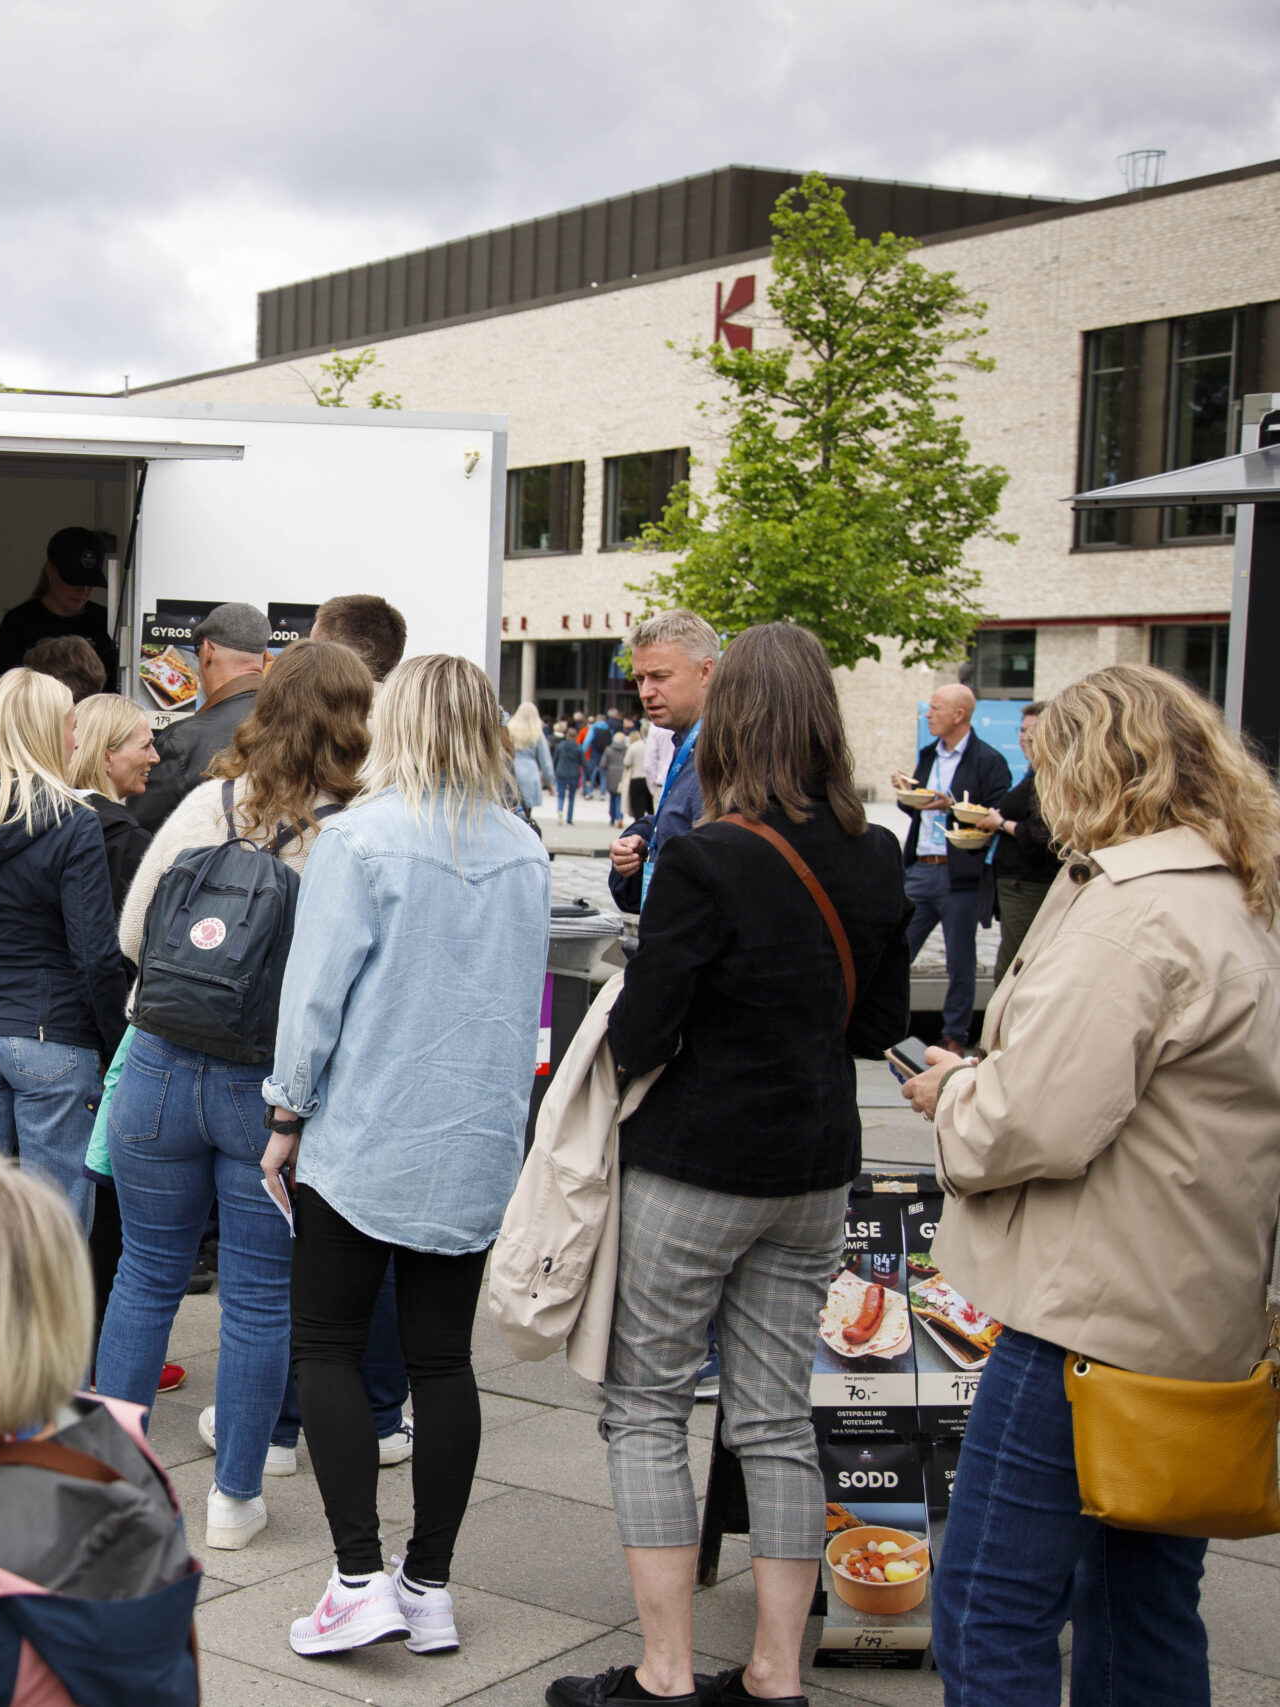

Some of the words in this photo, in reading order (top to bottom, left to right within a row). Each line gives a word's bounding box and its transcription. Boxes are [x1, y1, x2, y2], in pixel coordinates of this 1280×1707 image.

[561, 611, 656, 630] KULT
[151, 626, 192, 638] GYROS
[844, 1221, 882, 1238] LSE
[838, 1471, 899, 1489] SODD
